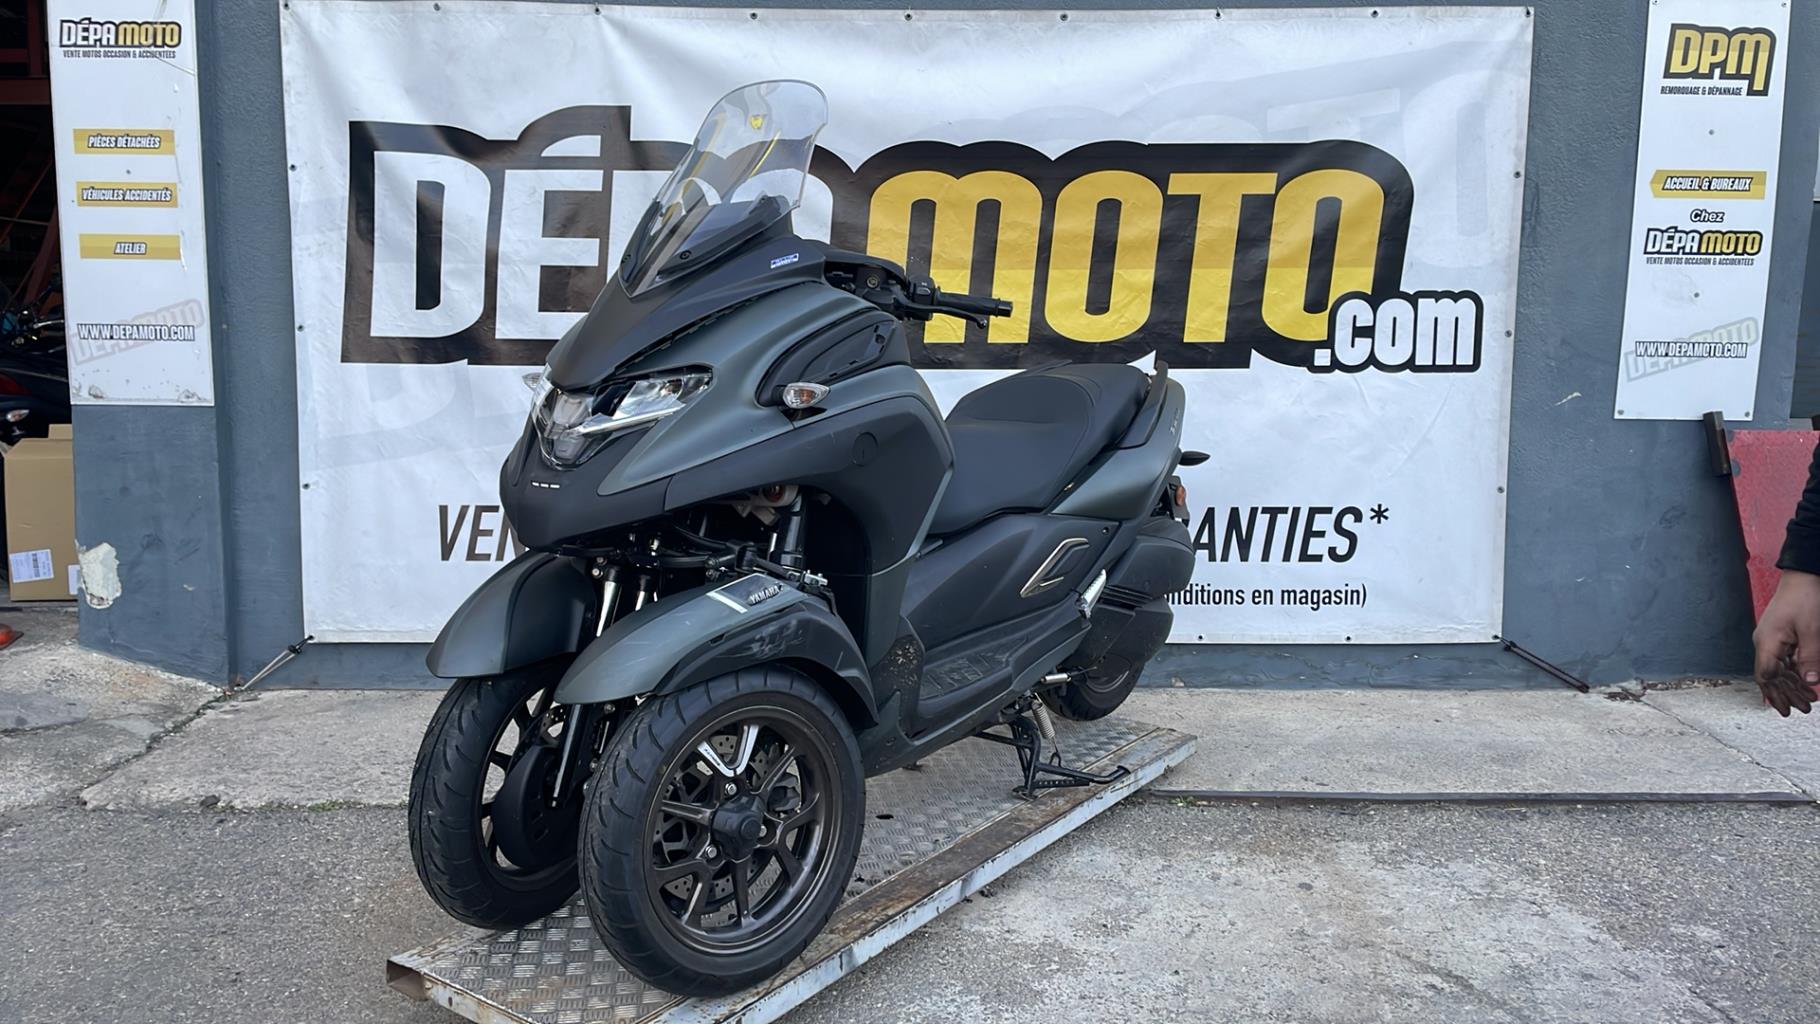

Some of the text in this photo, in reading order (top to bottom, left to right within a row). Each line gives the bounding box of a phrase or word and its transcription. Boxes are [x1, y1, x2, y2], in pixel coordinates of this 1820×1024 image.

[60, 18, 181, 47] DÉPAMOTO
[63, 50, 81, 59] VENTE
[82, 50, 102, 59] MOTOS
[103, 50, 131, 59] OCCASION
[132, 50, 137, 59] &
[1666, 25, 1774, 94] DPM
[1660, 85, 1701, 95] REMORQUAGE
[1701, 86, 1706, 95] &
[88, 133, 161, 149] PIÈCES DÉTACHÉES
[1662, 176, 1753, 191] ACCUEIL & BUREAUX
[82, 186, 172, 202] VÉHICULES ACCIDENTÉS
[1690, 208, 1725, 222] Chez
[114, 242, 147, 255] ATELIER
[1644, 226, 1763, 255] DÉPAMOTO
[1646, 256, 1664, 265] VENTE
[1664, 257, 1683, 265] MOTOS
[1683, 257, 1711, 266] OCCASION
[1712, 257, 1717, 266] &
[77, 323, 195, 341] WWW.DEPAMOTO.COM
[1635, 341, 1748, 358] WWW.DEPAMOTO.COM
[1165, 583, 1367, 611] nditions en magasin)
